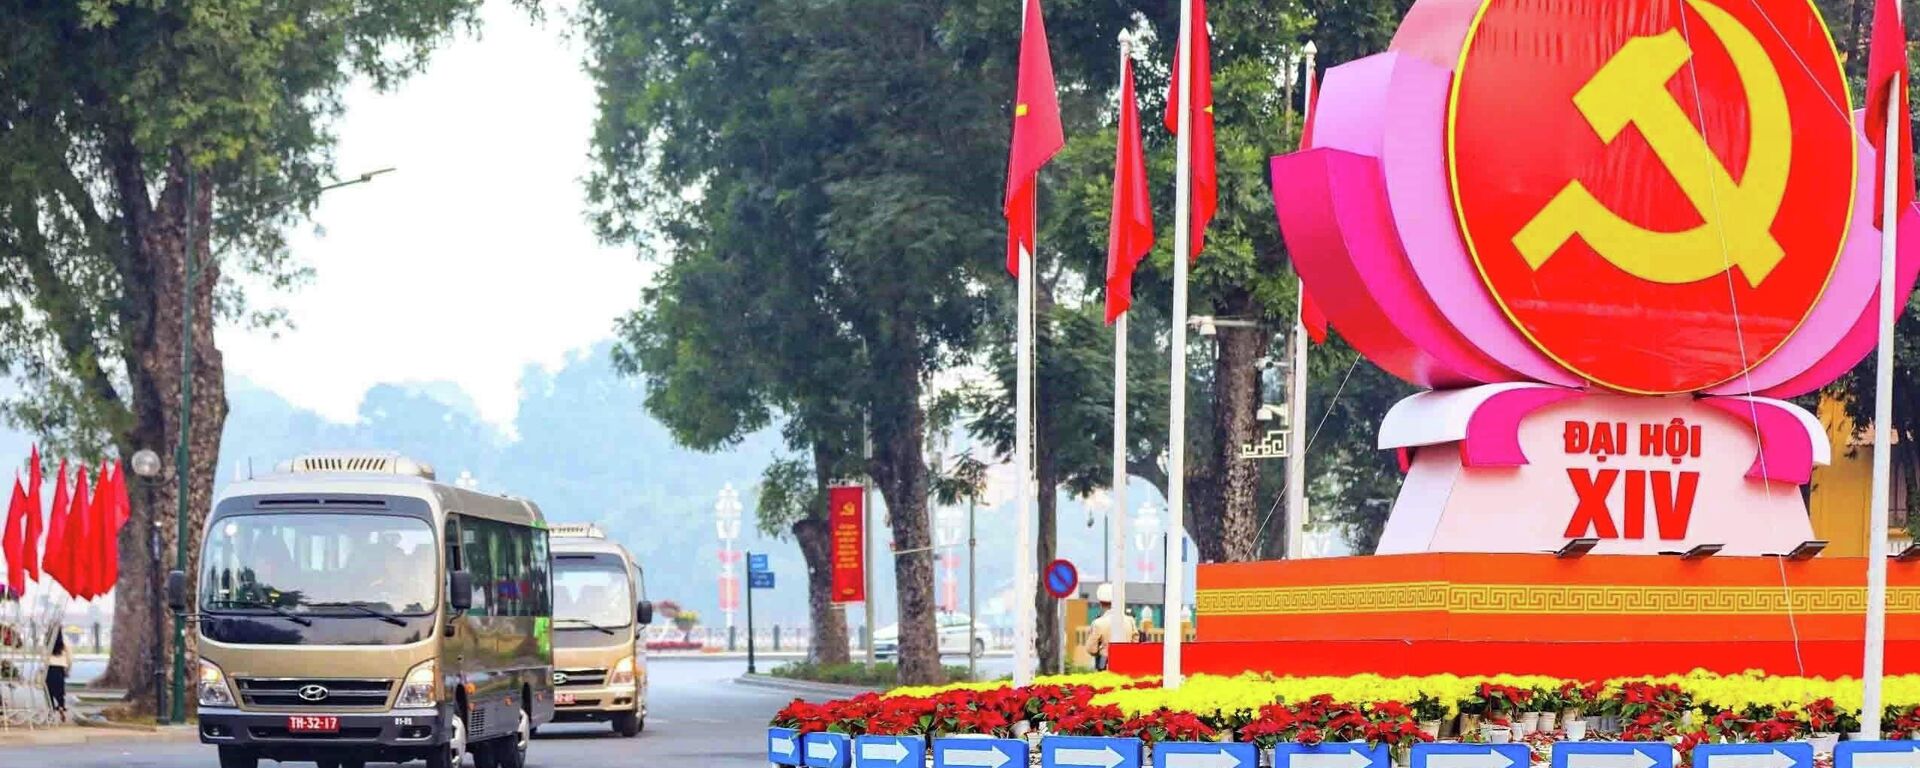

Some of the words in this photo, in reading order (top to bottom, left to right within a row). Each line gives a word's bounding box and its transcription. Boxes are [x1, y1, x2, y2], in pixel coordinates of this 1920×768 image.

[1563, 421, 1627, 462] ĐẠI
[1640, 418, 1701, 464] HỘI
[1564, 468, 1700, 540] XIV
